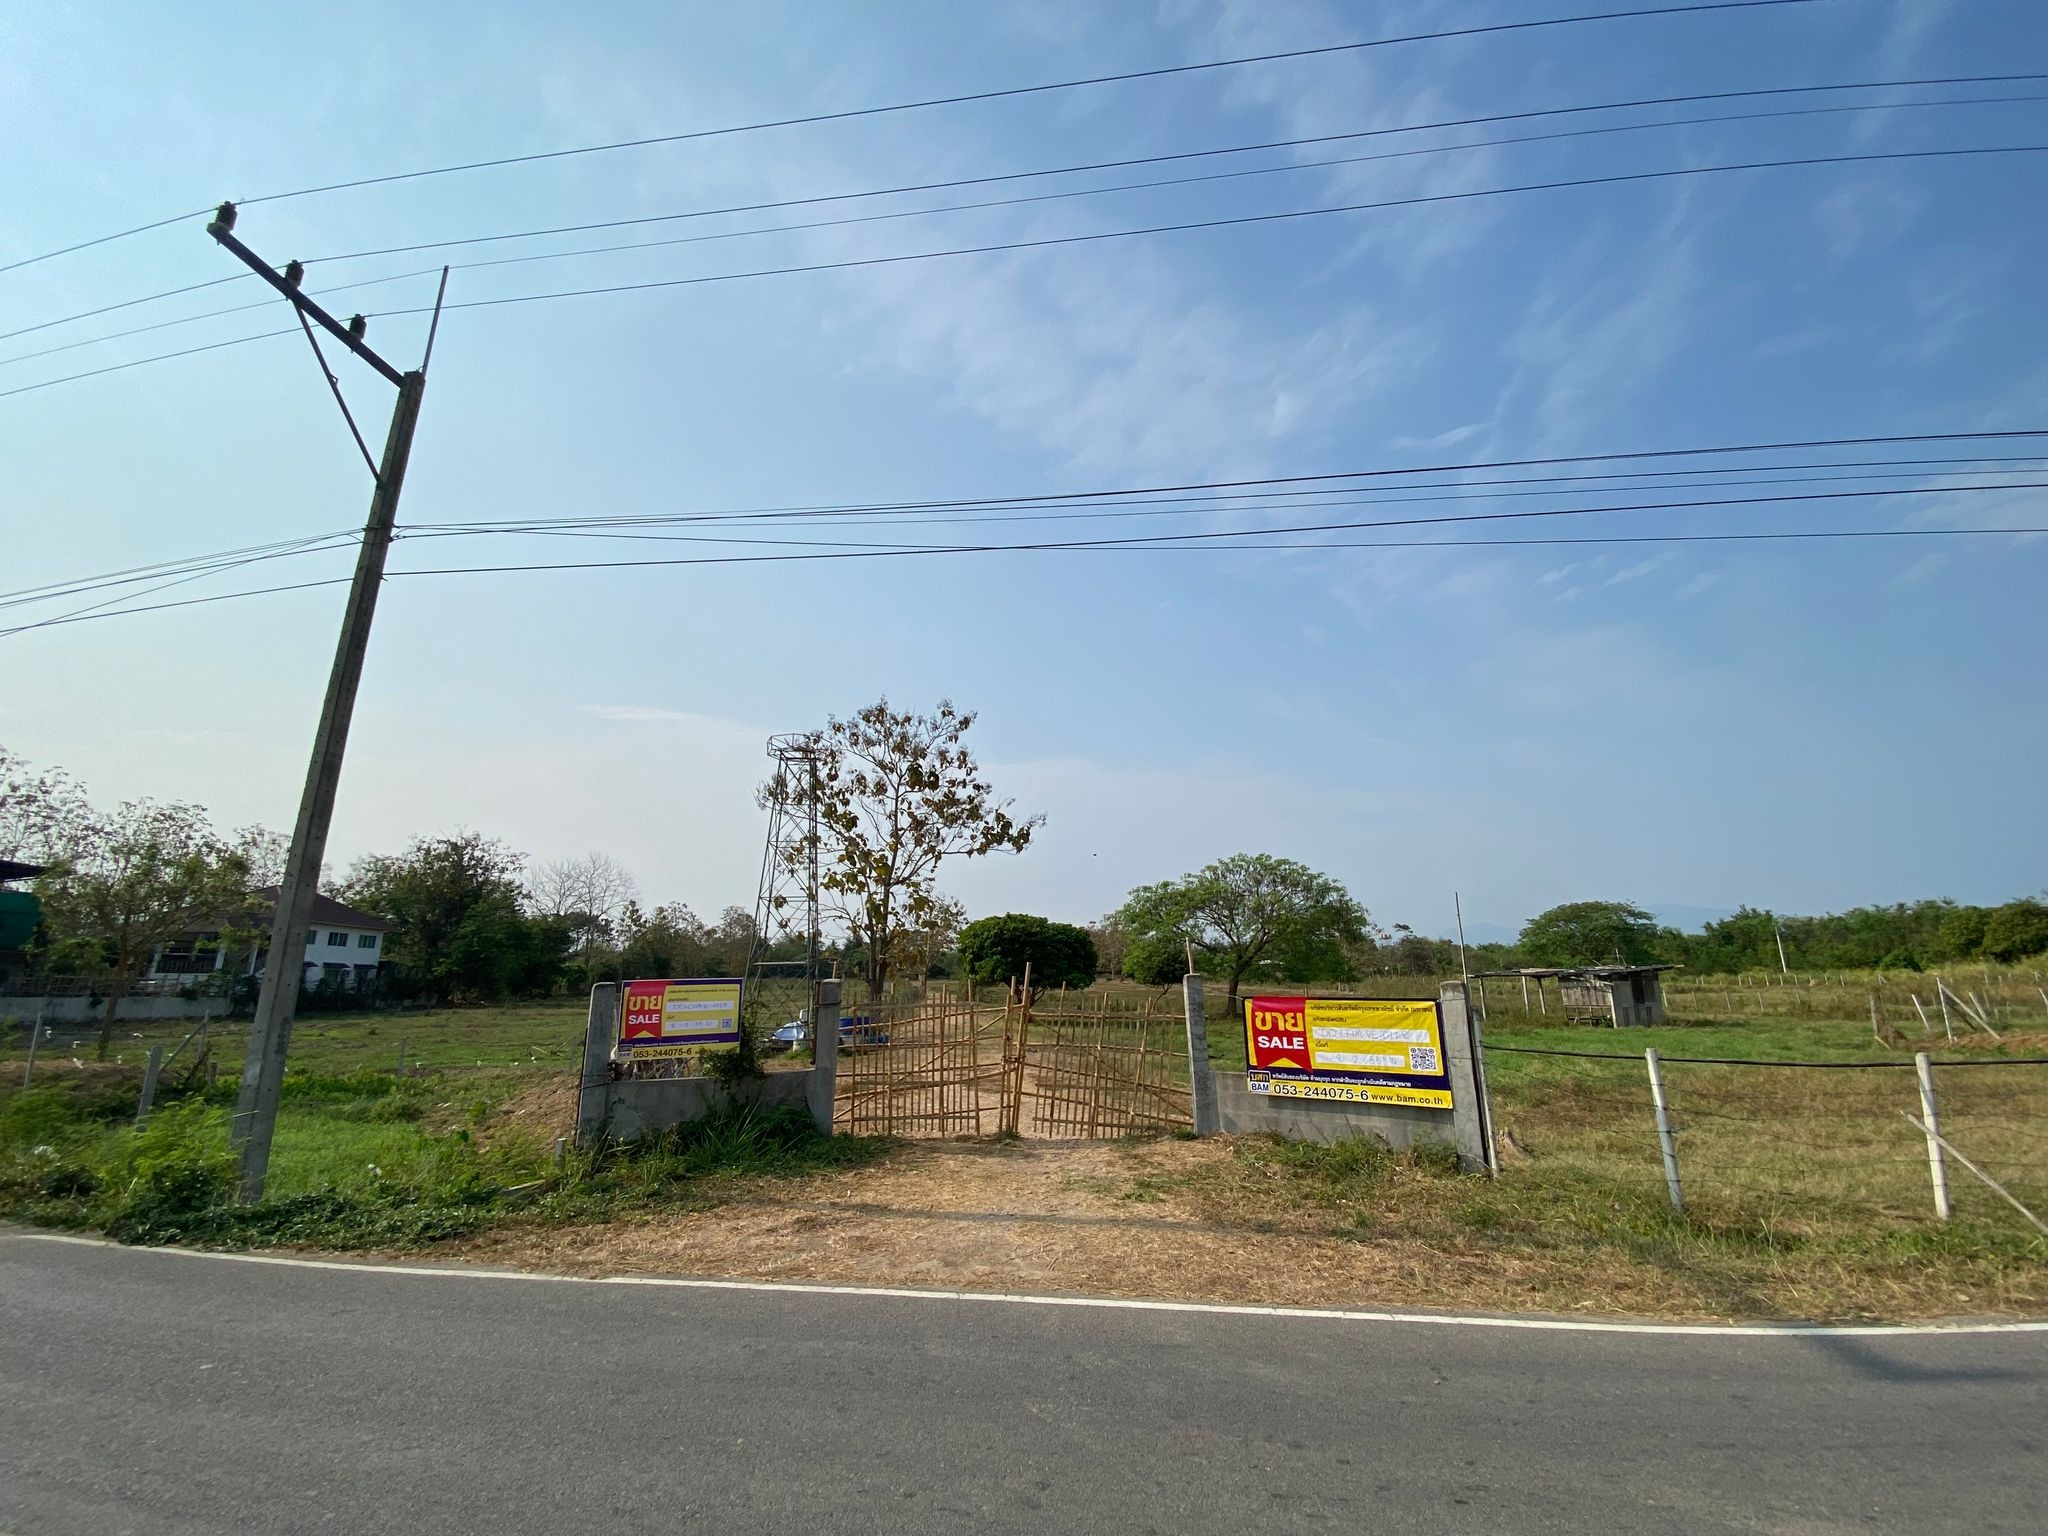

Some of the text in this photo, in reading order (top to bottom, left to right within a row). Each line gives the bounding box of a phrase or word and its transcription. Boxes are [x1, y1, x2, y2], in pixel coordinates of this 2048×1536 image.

[629, 995, 661, 1011] ขาย
[628, 1013, 660, 1025] SALE
[1254, 1011, 1304, 1032] ขาย
[1257, 1035, 1305, 1050] SALE
[633, 1047, 692, 1059] 053-244075-6
[1251, 1083, 1269, 1091] BAM
[1273, 1083, 1443, 1105] 053-244075-6 www.bam.co.th
